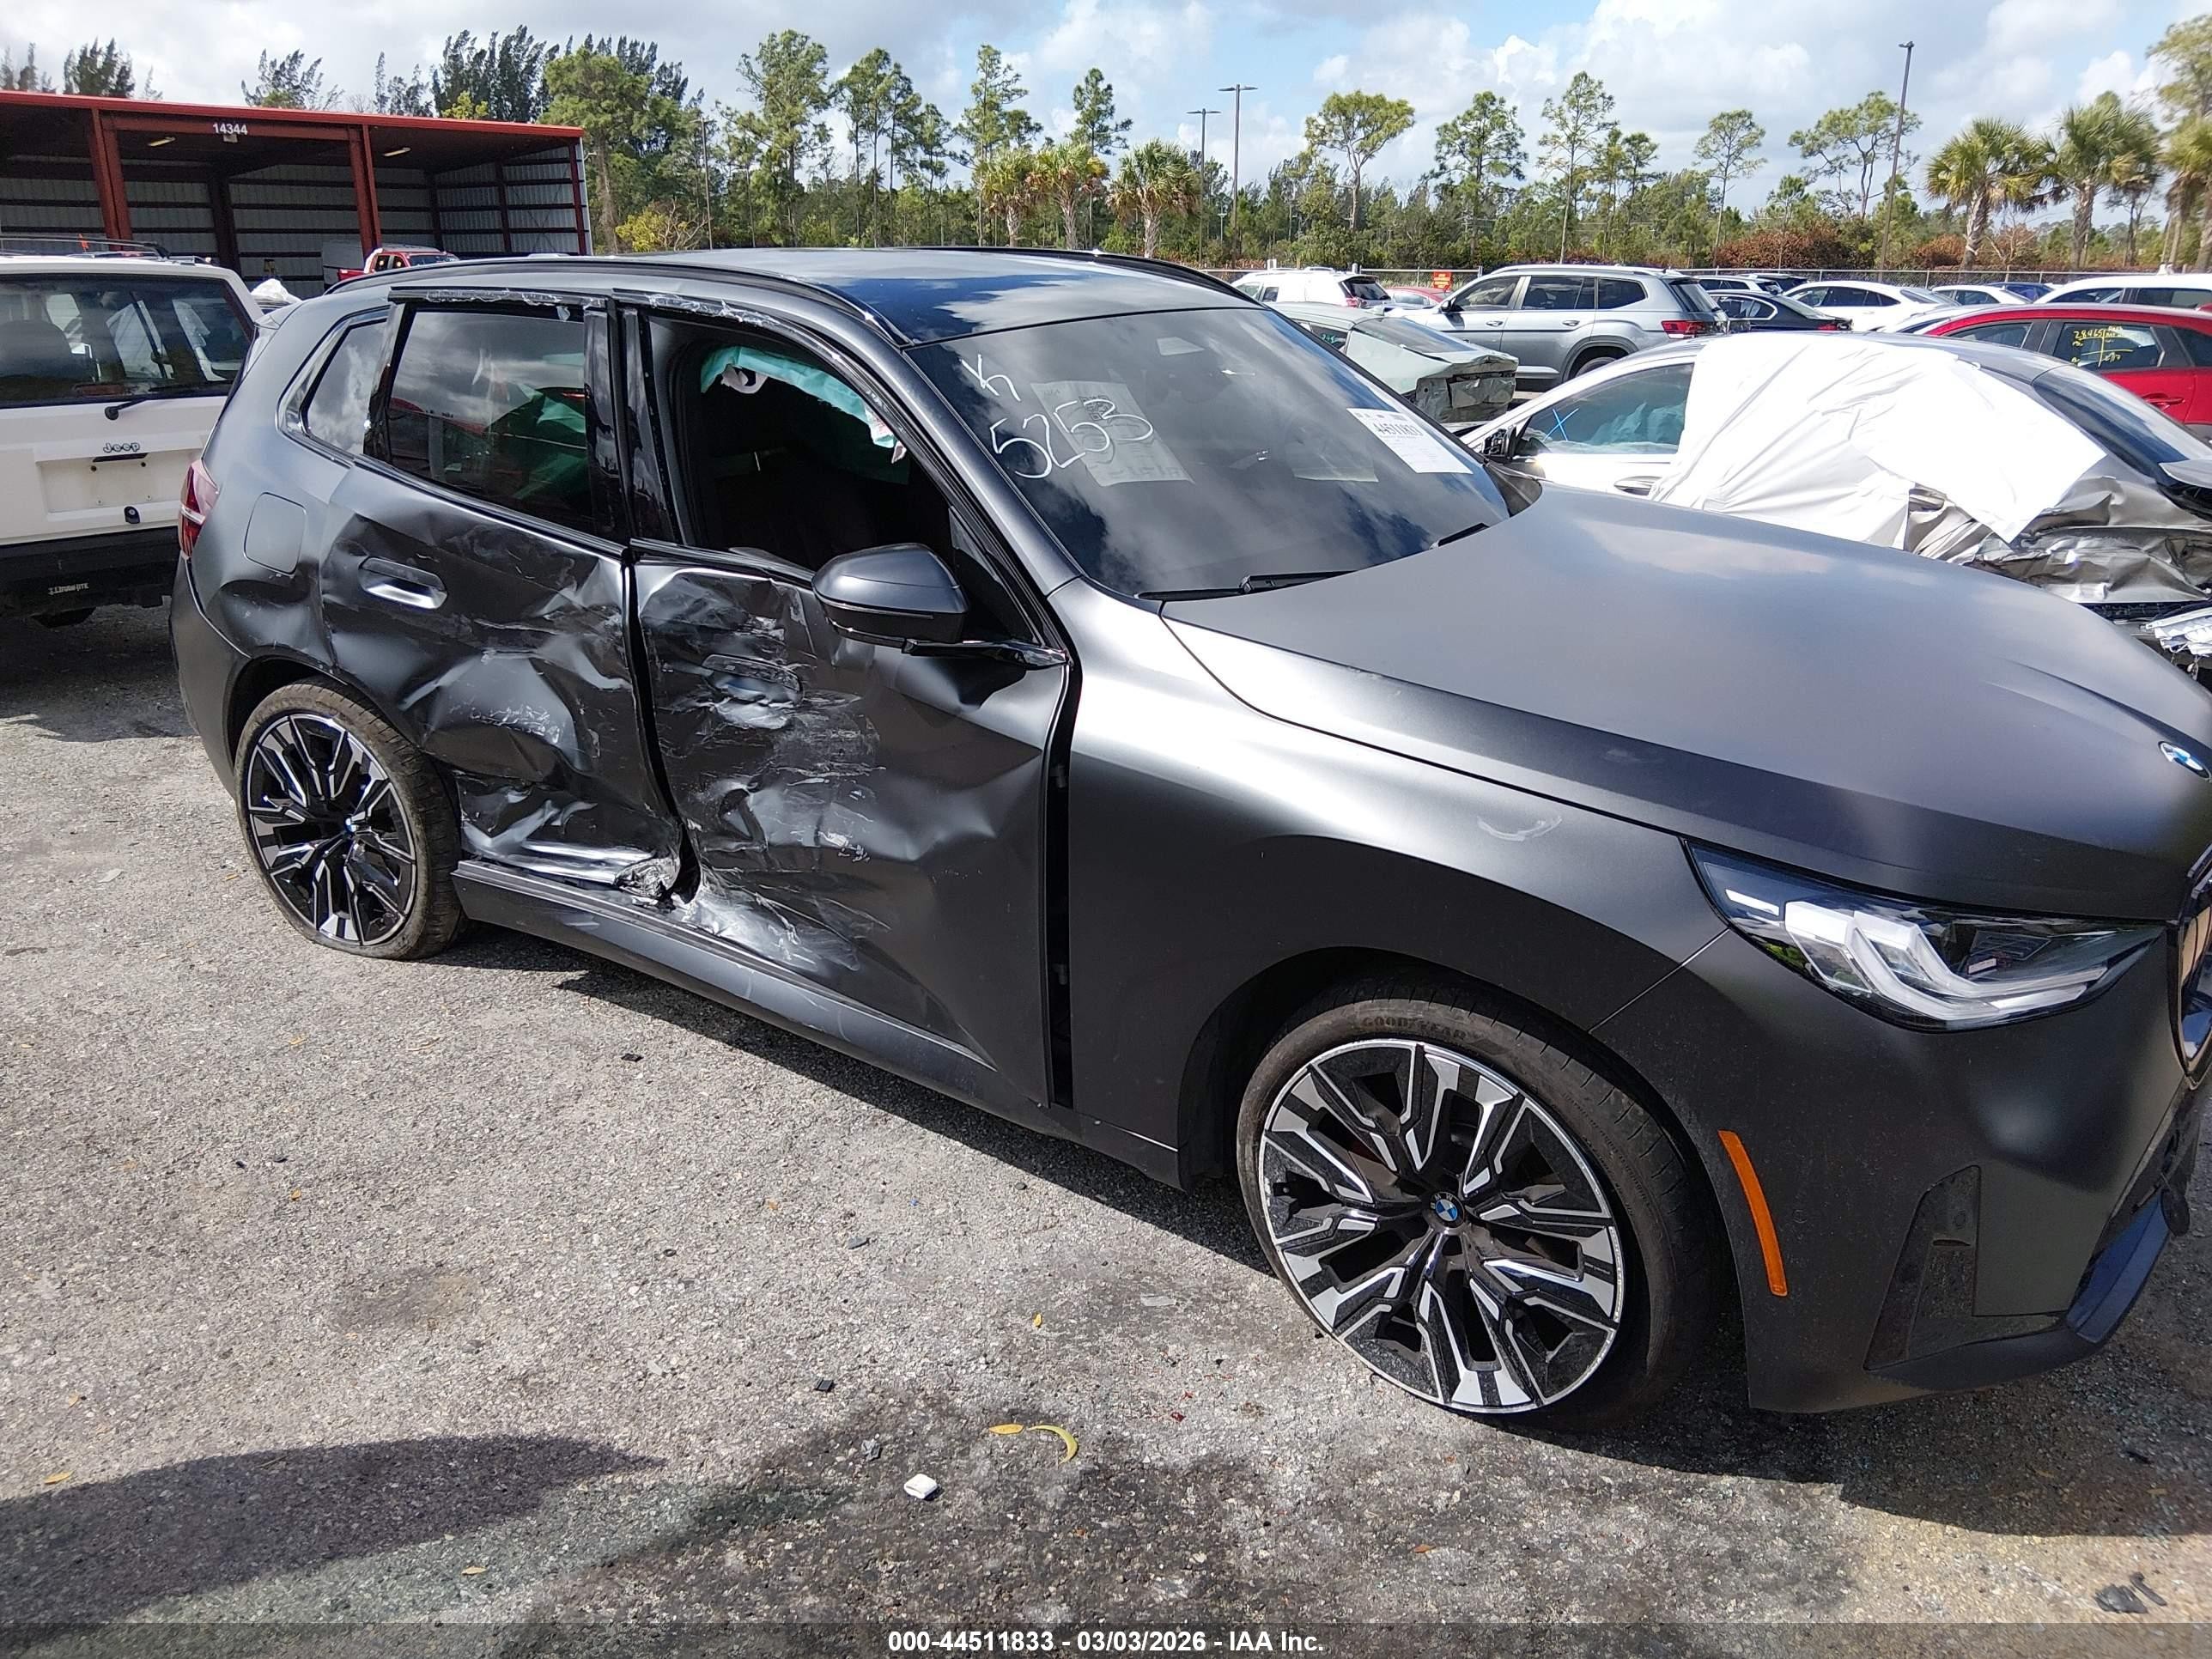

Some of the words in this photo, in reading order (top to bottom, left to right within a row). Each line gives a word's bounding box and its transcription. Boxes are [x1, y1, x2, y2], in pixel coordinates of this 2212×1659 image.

[213, 122, 247, 135] 14344
[989, 398, 1153, 479] 5253
[102, 442, 140, 453] Jeep
